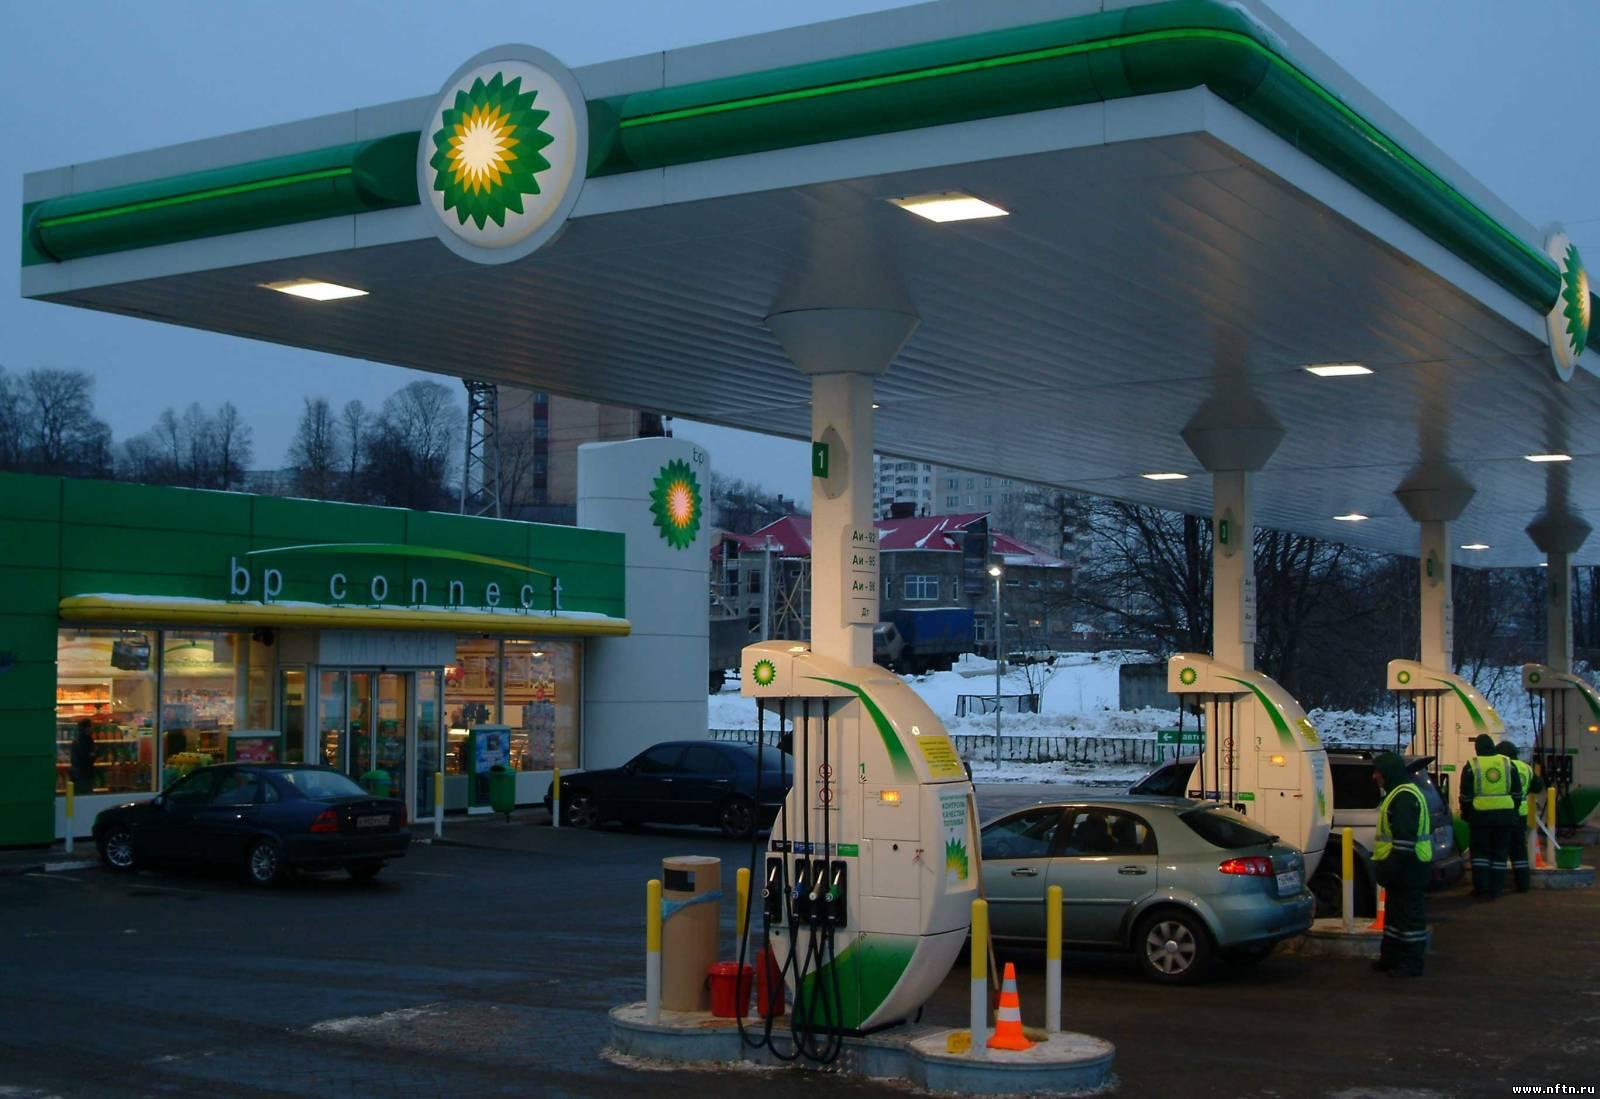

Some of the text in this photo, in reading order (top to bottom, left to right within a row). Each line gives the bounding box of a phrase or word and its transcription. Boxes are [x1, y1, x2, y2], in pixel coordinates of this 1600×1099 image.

[818, 450, 824, 469] 1
[231, 556, 563, 610] bp connect
